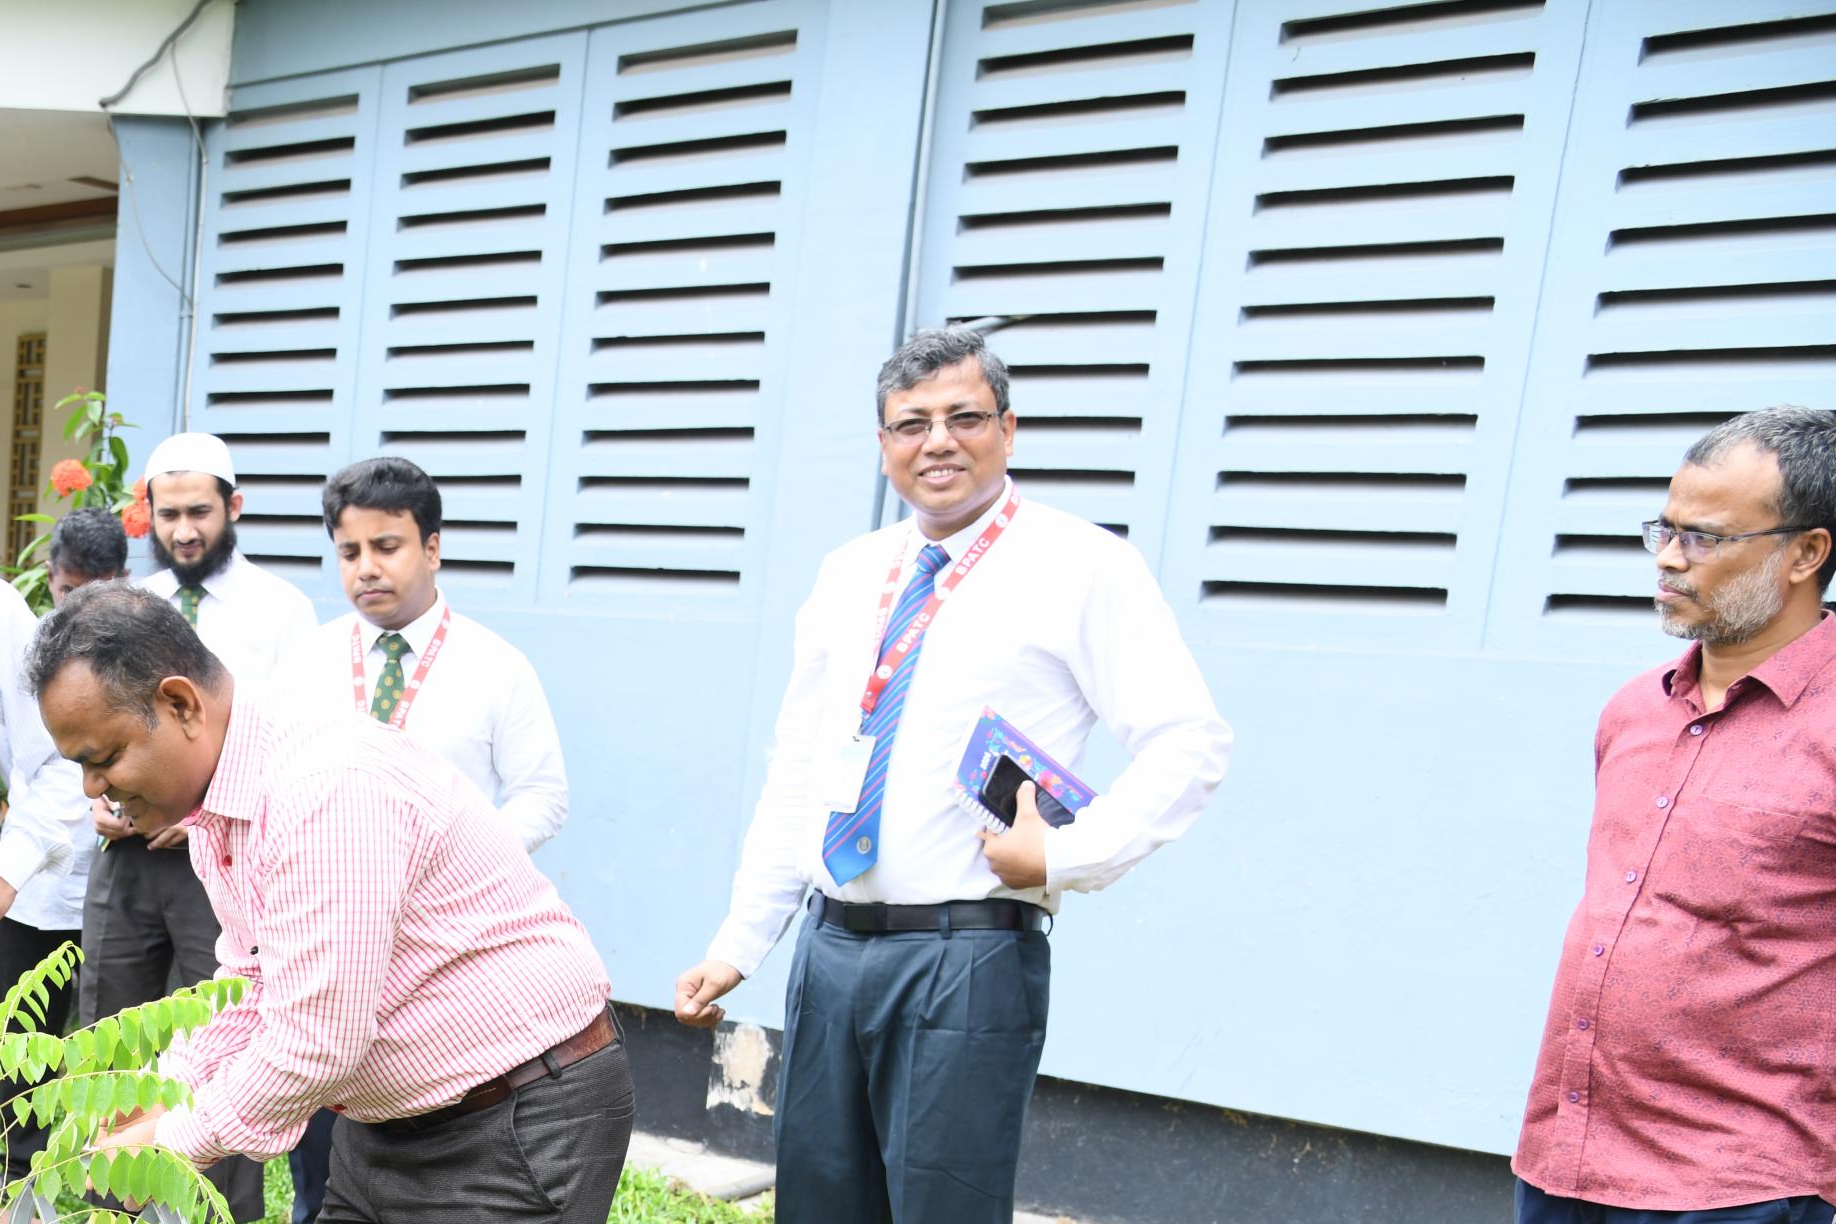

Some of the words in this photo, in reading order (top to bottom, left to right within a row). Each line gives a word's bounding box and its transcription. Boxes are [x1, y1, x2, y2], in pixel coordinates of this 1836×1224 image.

[954, 537, 991, 576] BPATC
[895, 612, 931, 653] BPATC
[419, 638, 443, 668] BPATC
